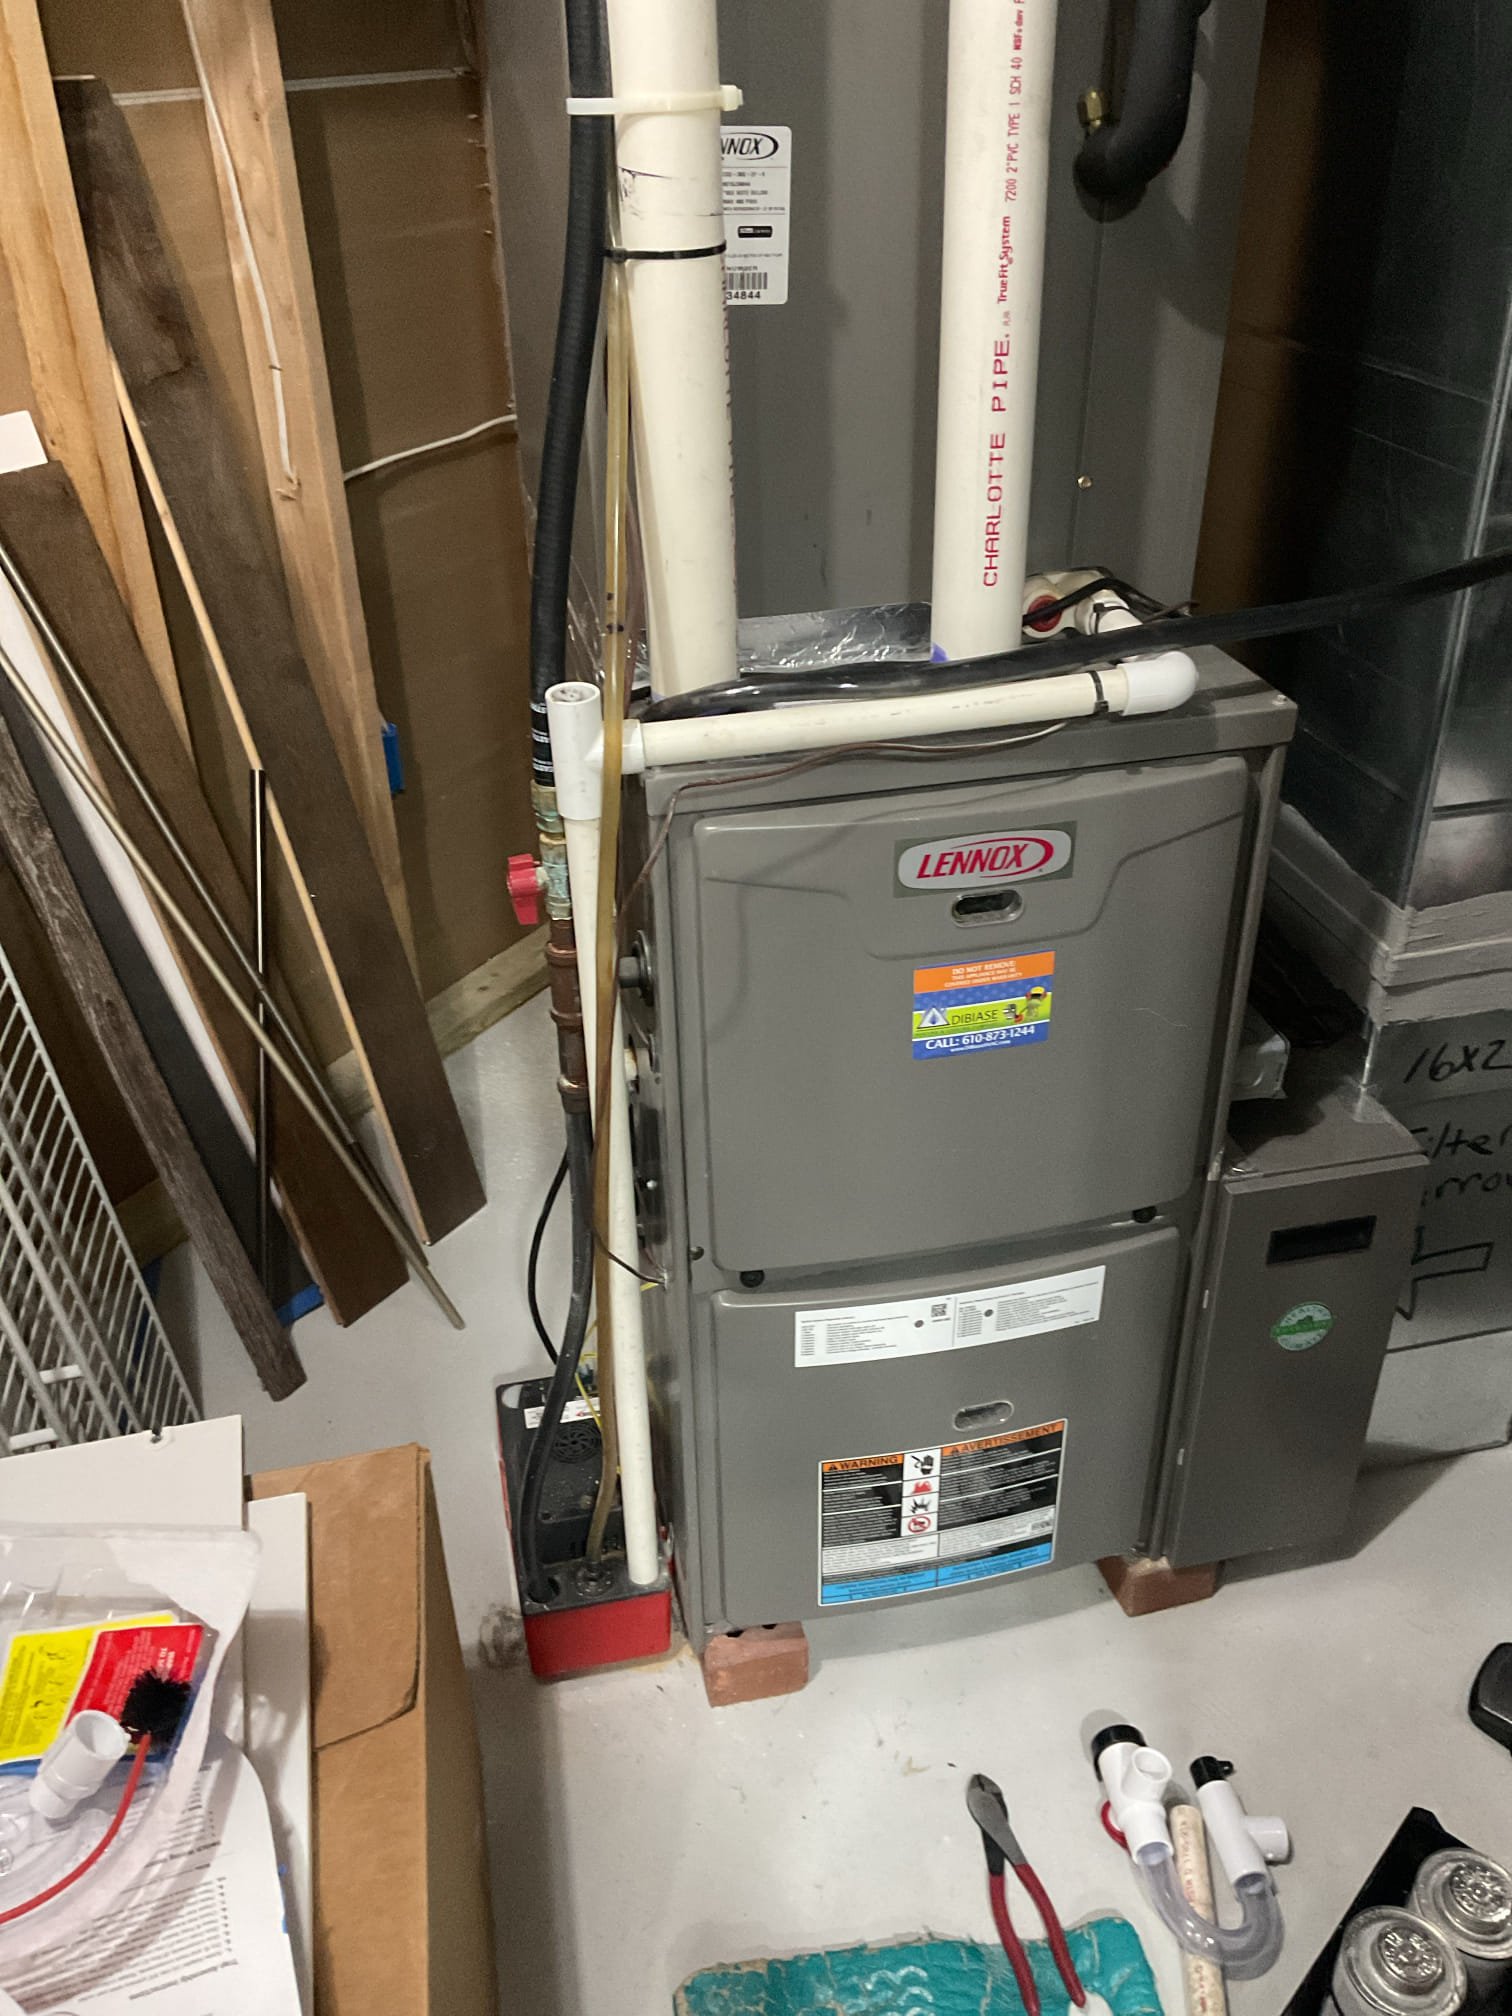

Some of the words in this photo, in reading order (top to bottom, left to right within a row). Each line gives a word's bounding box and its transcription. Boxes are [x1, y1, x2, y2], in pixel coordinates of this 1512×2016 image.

[1010, 57, 1022, 71] 40
[1009, 76, 1022, 95] SCH
[1007, 113, 1020, 137] TYPE
[1004, 179, 1016, 202] 7200
[983, 433, 1005, 588] CHARLOTTE
[916, 843, 1029, 879] LENNOX
[951, 1009, 999, 1026] DIBIASE
[925, 1037, 960, 1050] CALL:
[962, 1025, 1036, 1045] 610-873-1244
[962, 1424, 1057, 1452] AVERTISSEMENT
[839, 1456, 898, 1471] WARNING
